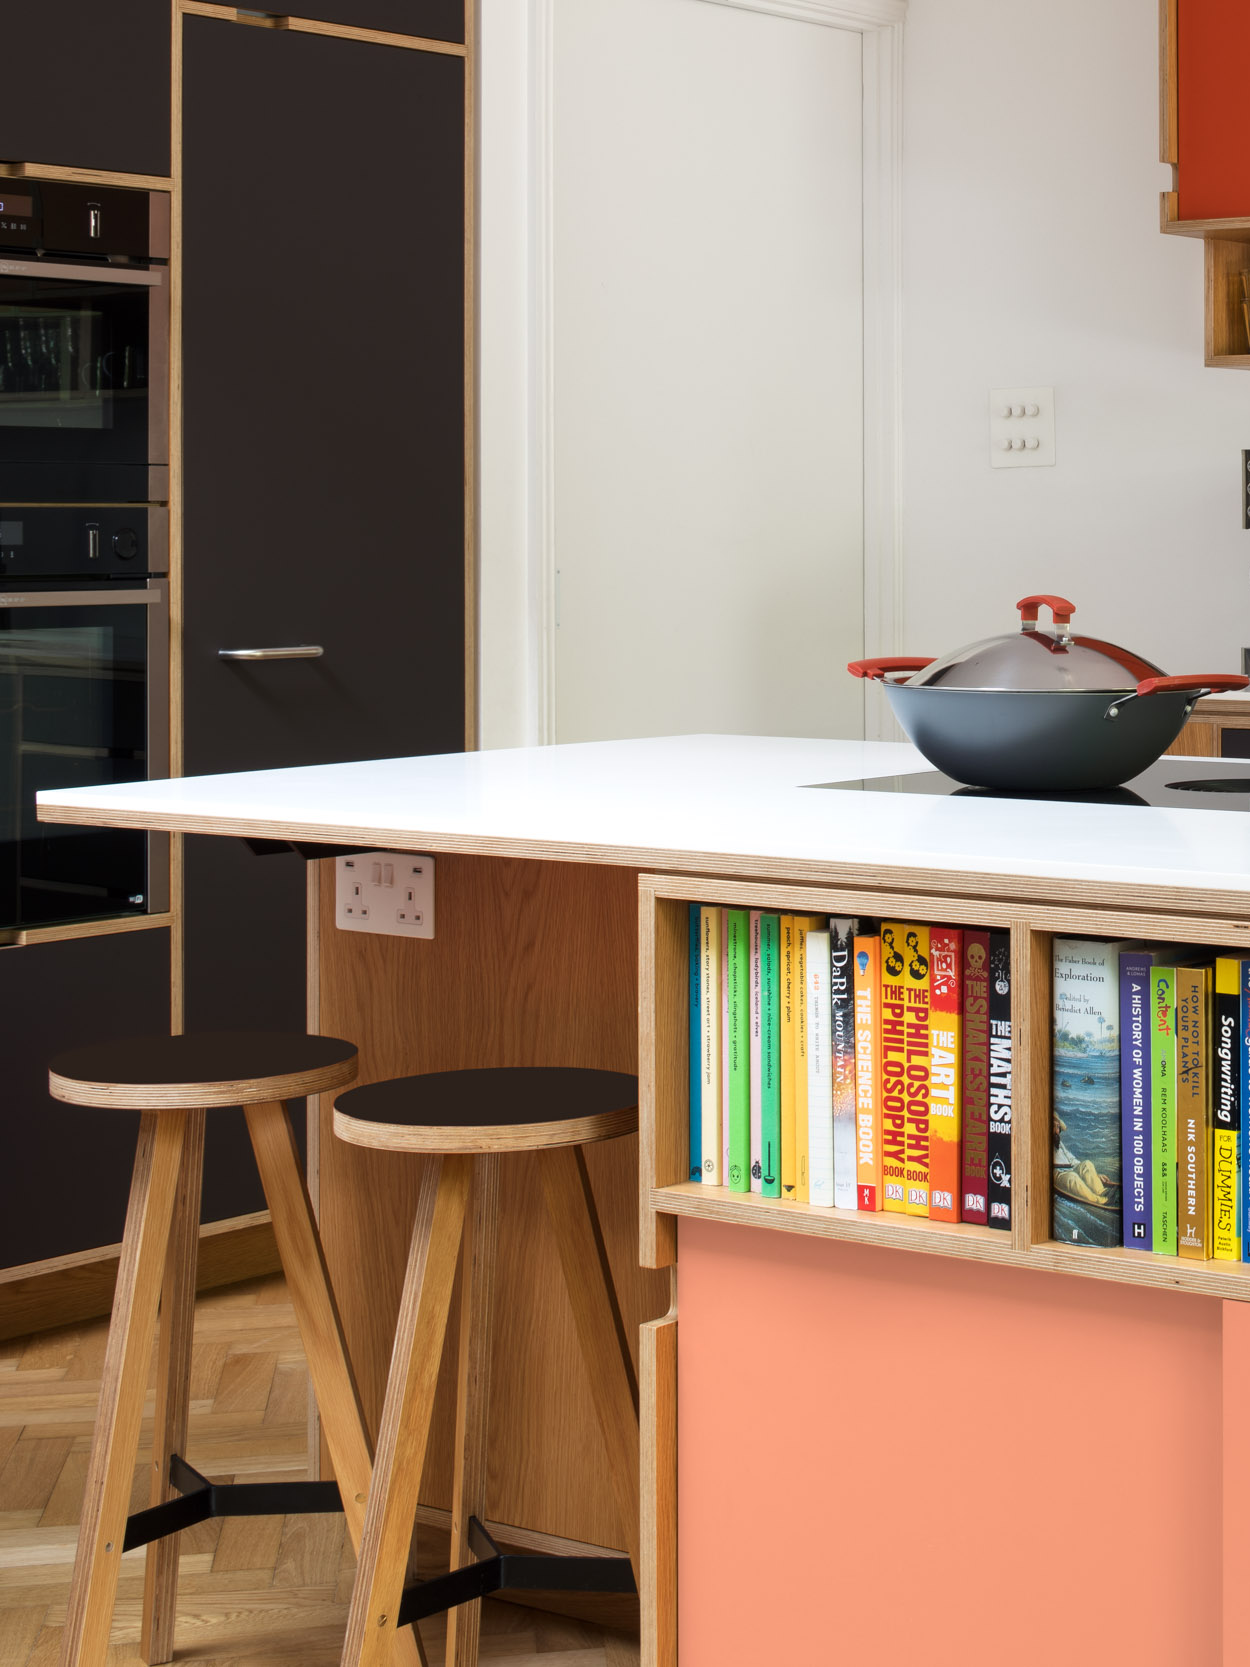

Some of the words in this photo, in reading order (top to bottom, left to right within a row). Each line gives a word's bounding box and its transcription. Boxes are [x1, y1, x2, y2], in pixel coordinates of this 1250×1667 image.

[1054, 967, 1105, 983] Exploration
[883, 985, 905, 1001] THE
[906, 988, 929, 1004] THE
[966, 981, 987, 997] THE
[1131, 984, 1142, 992] A
[857, 987, 871, 1023] THE
[1055, 1003, 1082, 1015] Benedict
[1084, 1006, 1102, 1016] Allen
[1157, 979, 1171, 1036] Content
[1191, 985, 1199, 1015] HOW
[1131, 995, 1142, 1047] HISTORY
[1181, 997, 1189, 1031] YOUR
[990, 1020, 1011, 1036] THE
[1191, 1020, 1199, 1046] NOT
[836, 1010, 845, 1083] MOUNTAIN
[931, 1030, 955, 1048] THE
[1132, 1049, 1142, 1066] OF
[1181, 1037, 1189, 1083] PLANTS
[1191, 1051, 1199, 1066] TO
[857, 1030, 873, 1107] SCIENCE
[931, 1047, 955, 1105] ART
[1218, 1015, 1235, 1122] Songwriting
[883, 1002, 905, 1164] PHILOSOPHY
[906, 1005, 929, 1168] PHILOSOPHY
[965, 997, 987, 1167] SHAKESPEARE
[990, 1037, 1011, 1121] MATHS
[1132, 1068, 1143, 1115] WOMEN
[931, 1103, 955, 1118] BOOK
[990, 1121, 1011, 1133] BOOK
[1133, 1118, 1143, 1131] IN
[1187, 1119, 1196, 1141] NIK
[859, 1113, 874, 1166] BOOK
[1133, 1134, 1144, 1154] 100
[883, 1166, 905, 1178] BOOK
[906, 1169, 929, 1183] BOOK
[966, 1165, 987, 1178] BOOK
[1187, 1146, 1196, 1216] SOUTHERN
[886, 1184, 903, 1199] DK
[1134, 1157, 1144, 1212] OBJECTS
[1217, 1145, 1233, 1231] DUMMIES
[909, 1190, 927, 1204] DK
[932, 1192, 951, 1207] DK
[966, 1194, 985, 1209] DK
[991, 1203, 1008, 1217] DK
